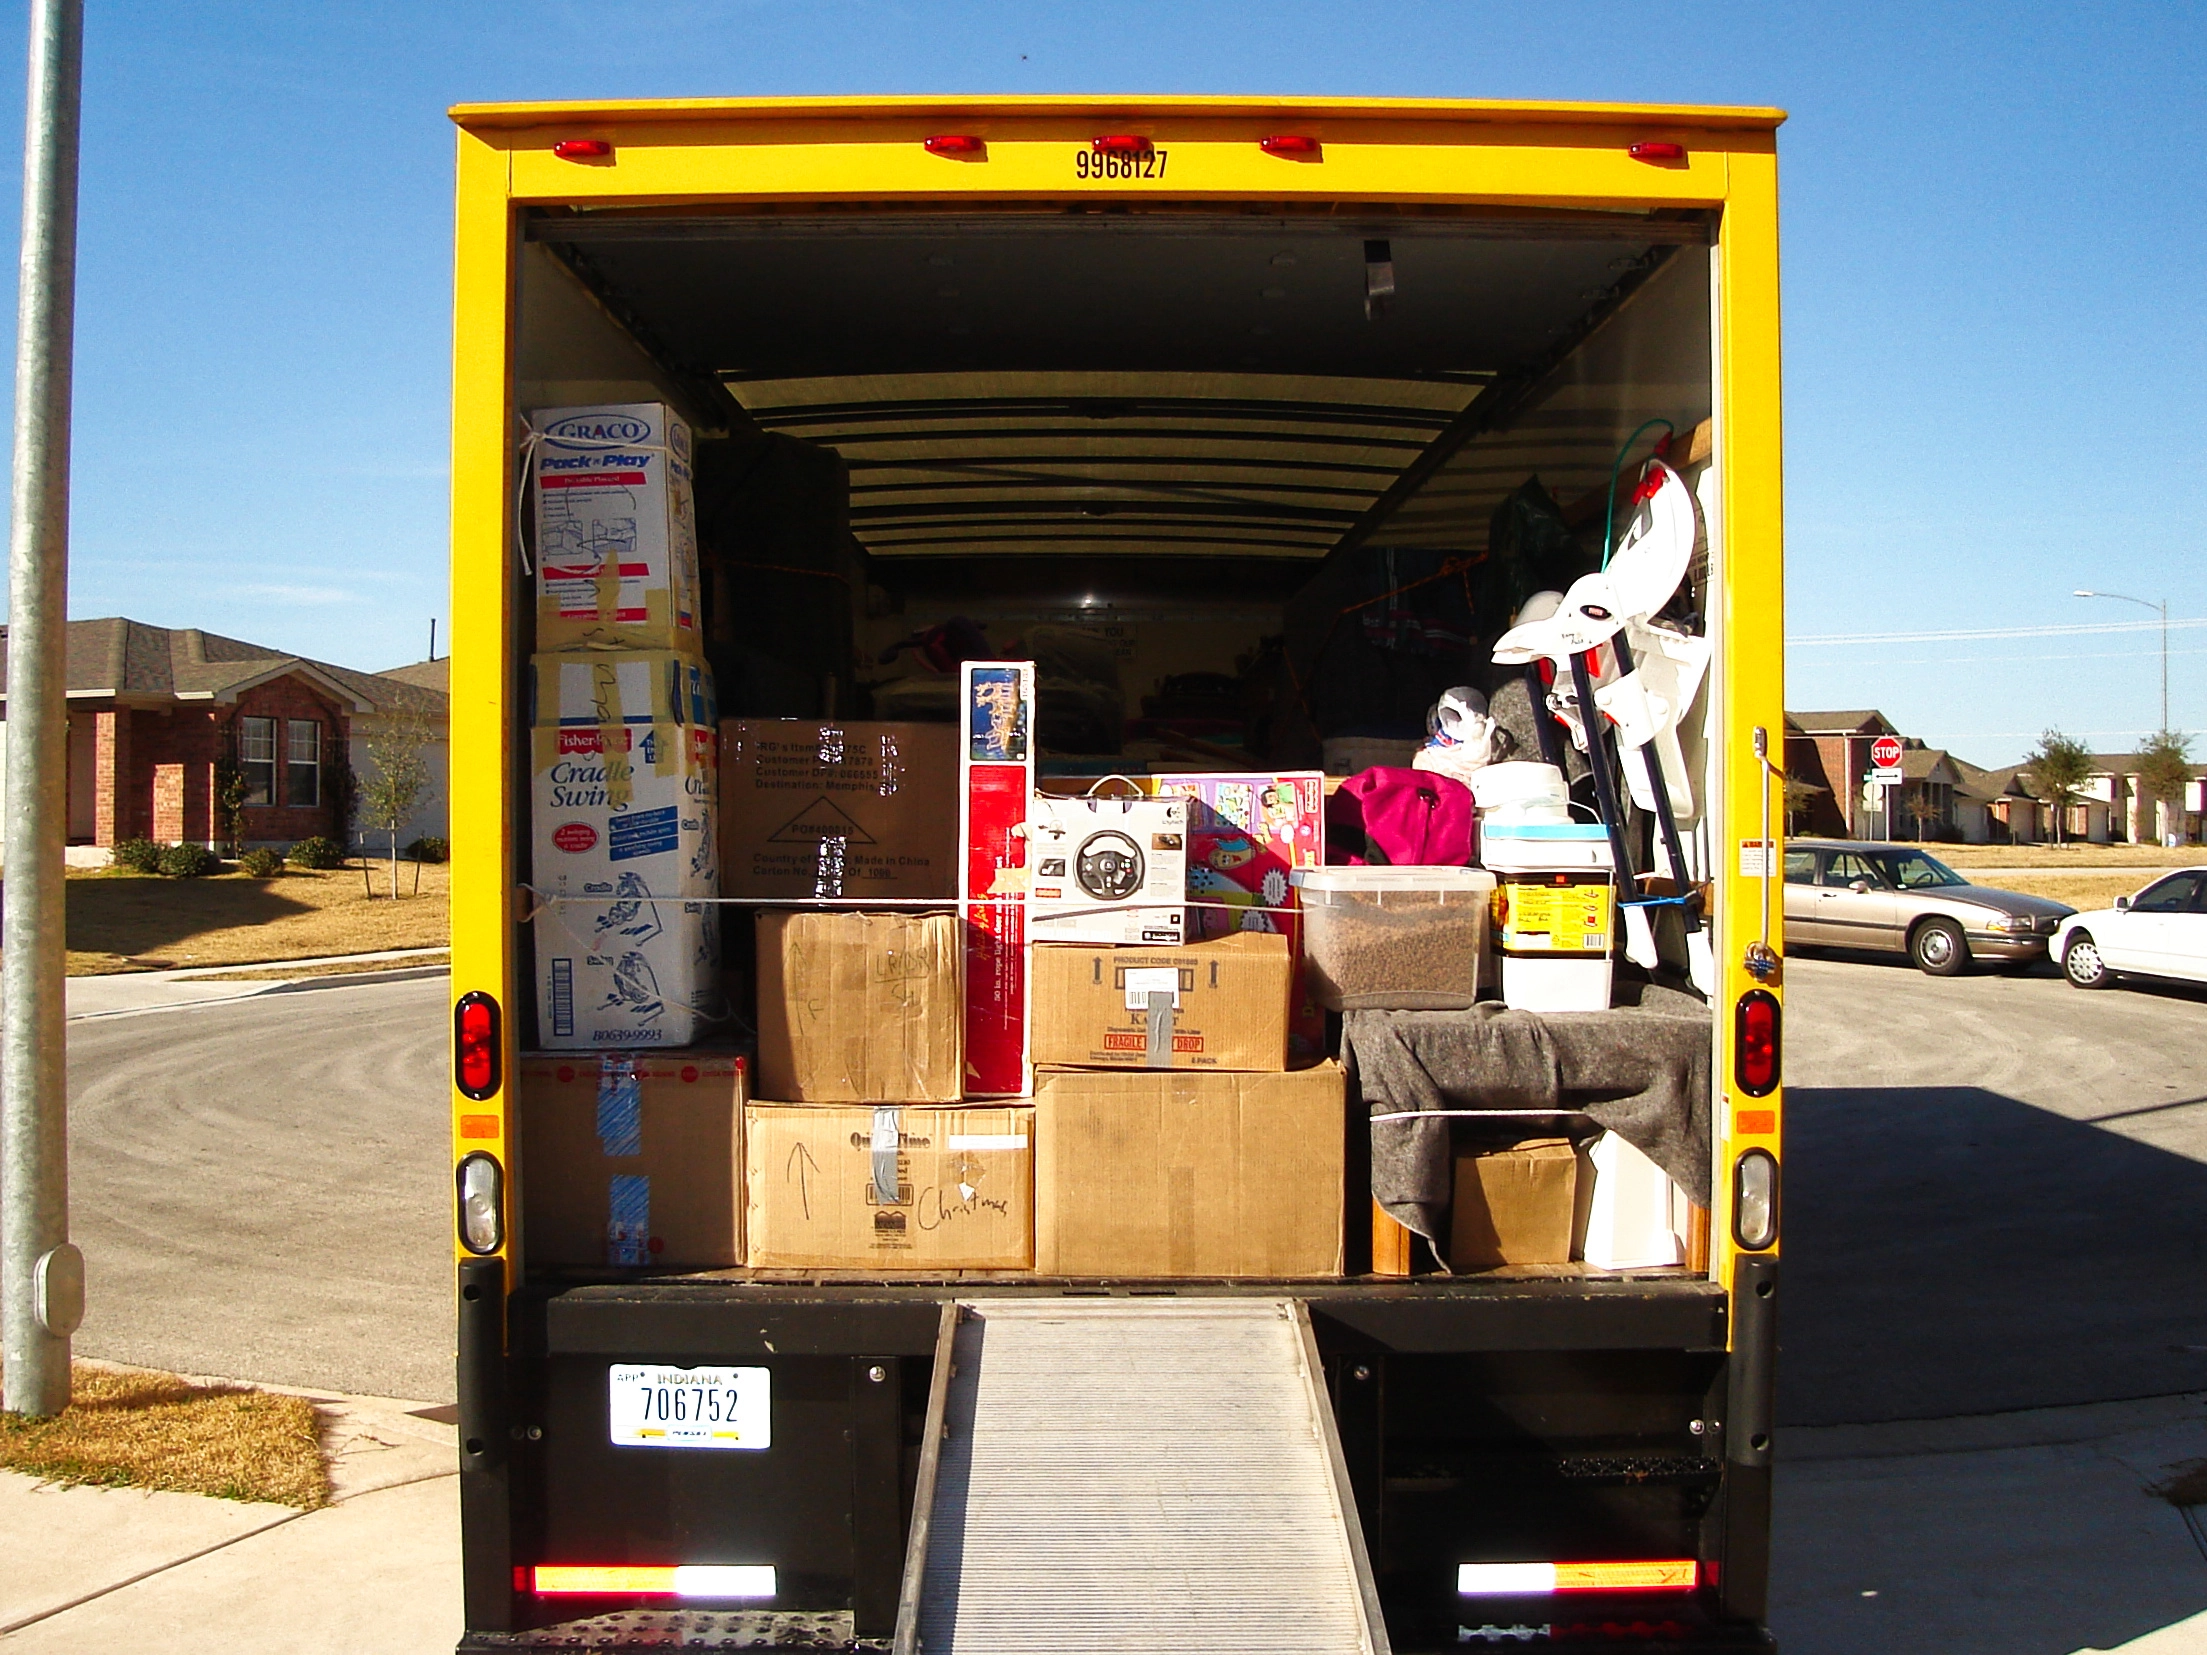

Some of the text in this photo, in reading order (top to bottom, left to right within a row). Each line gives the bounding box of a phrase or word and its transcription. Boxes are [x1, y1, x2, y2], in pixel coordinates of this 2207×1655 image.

[1076, 150, 1168, 179] 9968127
[558, 422, 640, 440] GRACO
[540, 455, 592, 471] Pack
[602, 454, 650, 468] Play
[1874, 746, 1900, 759] STOP
[550, 762, 635, 784] Cradle
[550, 785, 629, 812] Swing
[753, 853, 798, 866] Country
[855, 855, 884, 865] Made
[886, 855, 897, 865] in
[899, 855, 930, 866] China
[1113, 956, 1149, 965] PRODUCT
[1151, 957, 1172, 965] CODE
[1108, 1035, 1201, 1051] FRAGILE DROP
[616, 1373, 723, 1386] APP INDIANA
[641, 1387, 738, 1422] 706752
